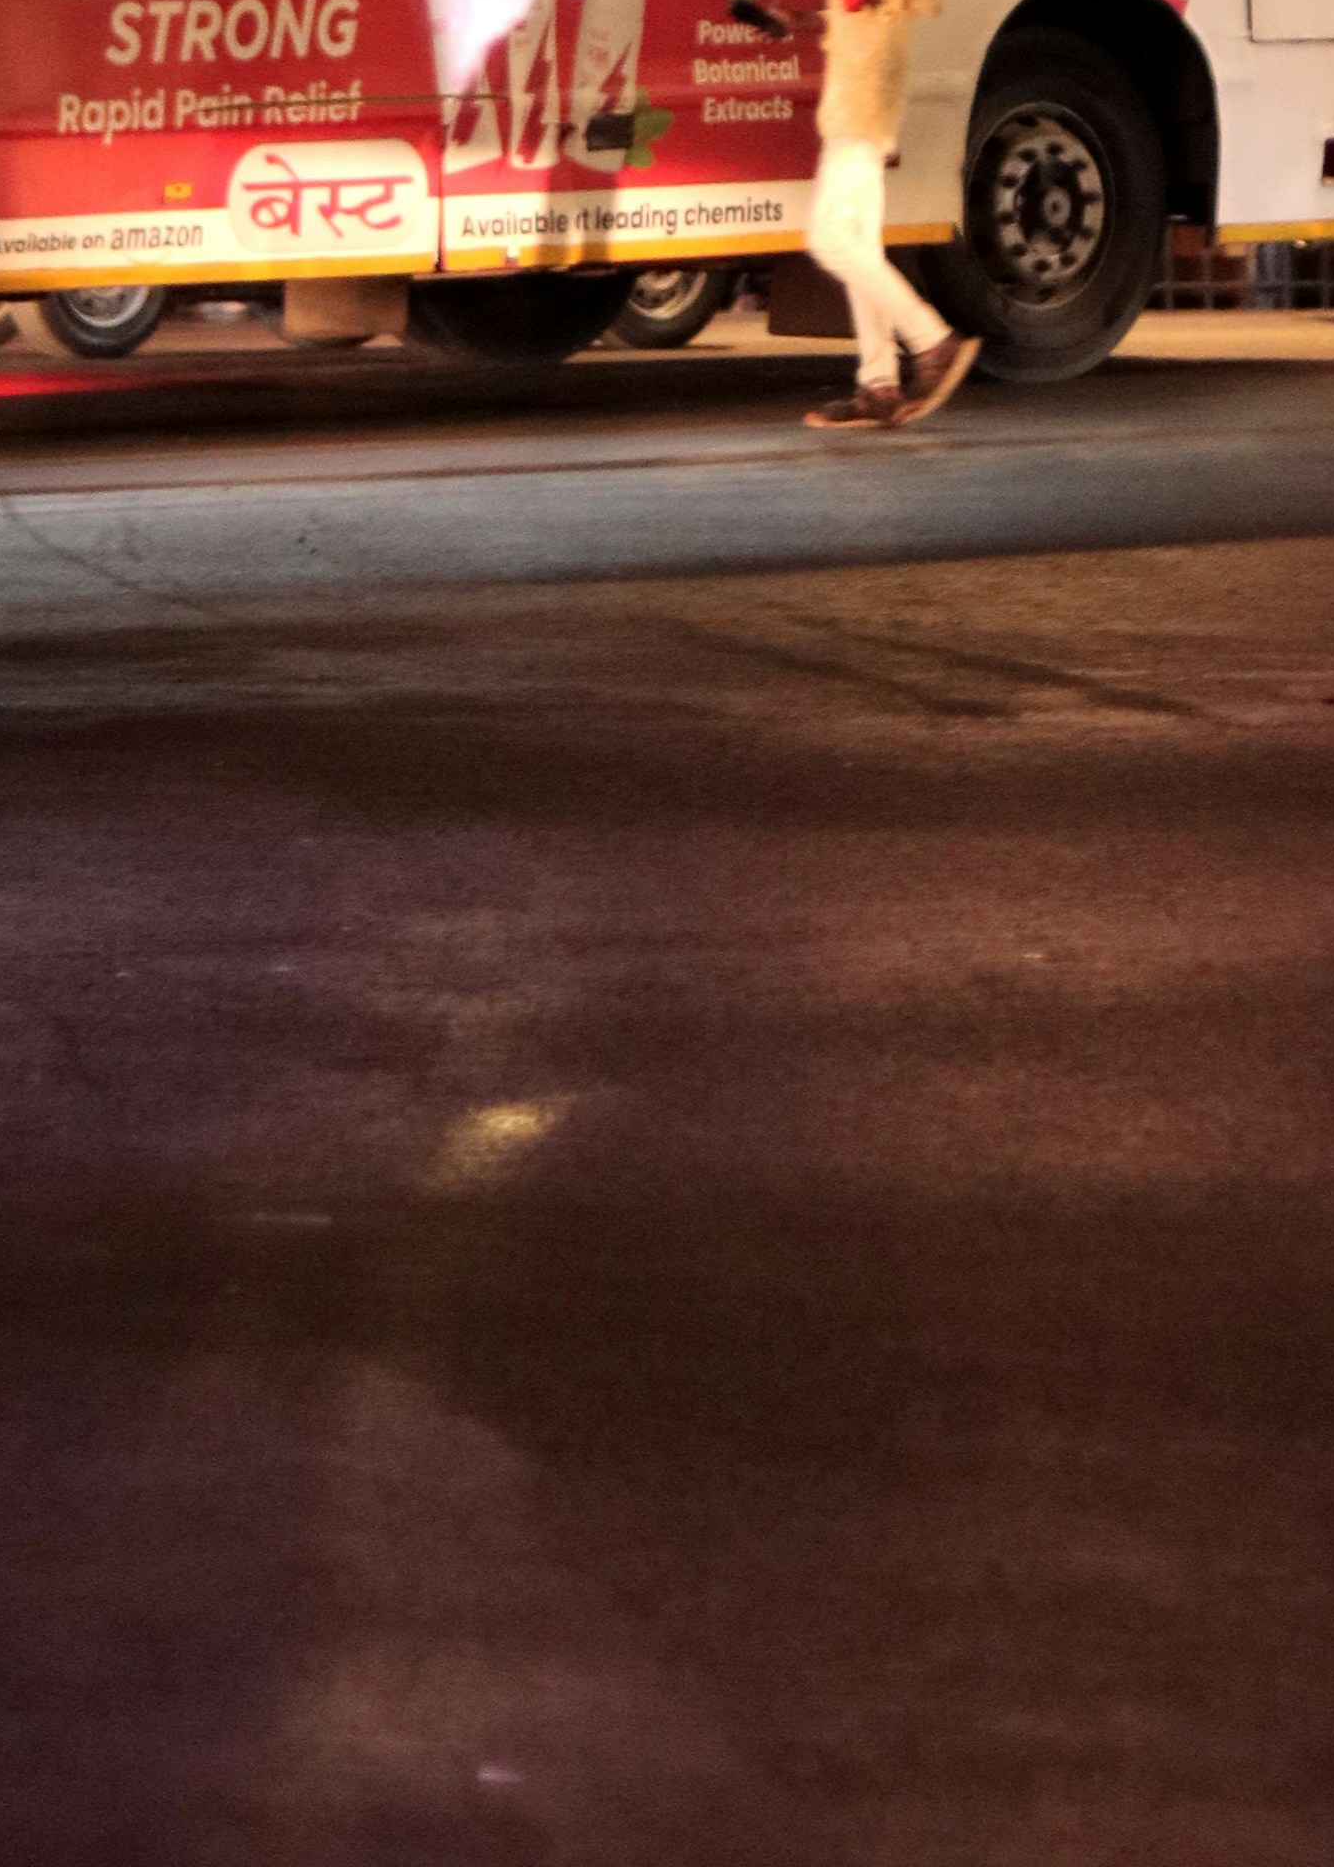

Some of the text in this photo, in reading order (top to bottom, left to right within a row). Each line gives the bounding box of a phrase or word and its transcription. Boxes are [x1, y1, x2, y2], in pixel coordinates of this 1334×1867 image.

[693, 55, 800, 85] Botanical
[57, 79, 364, 146] Rapid Pain Relief
[702, 94, 794, 124] Extracts
[242, 153, 413, 240] बेस्ट
[461, 208, 568, 239] Available
[595, 205, 678, 236] leading
[684, 196, 785, 227] chemists
[82, 233, 106, 250] on
[110, 224, 204, 251] amazon
